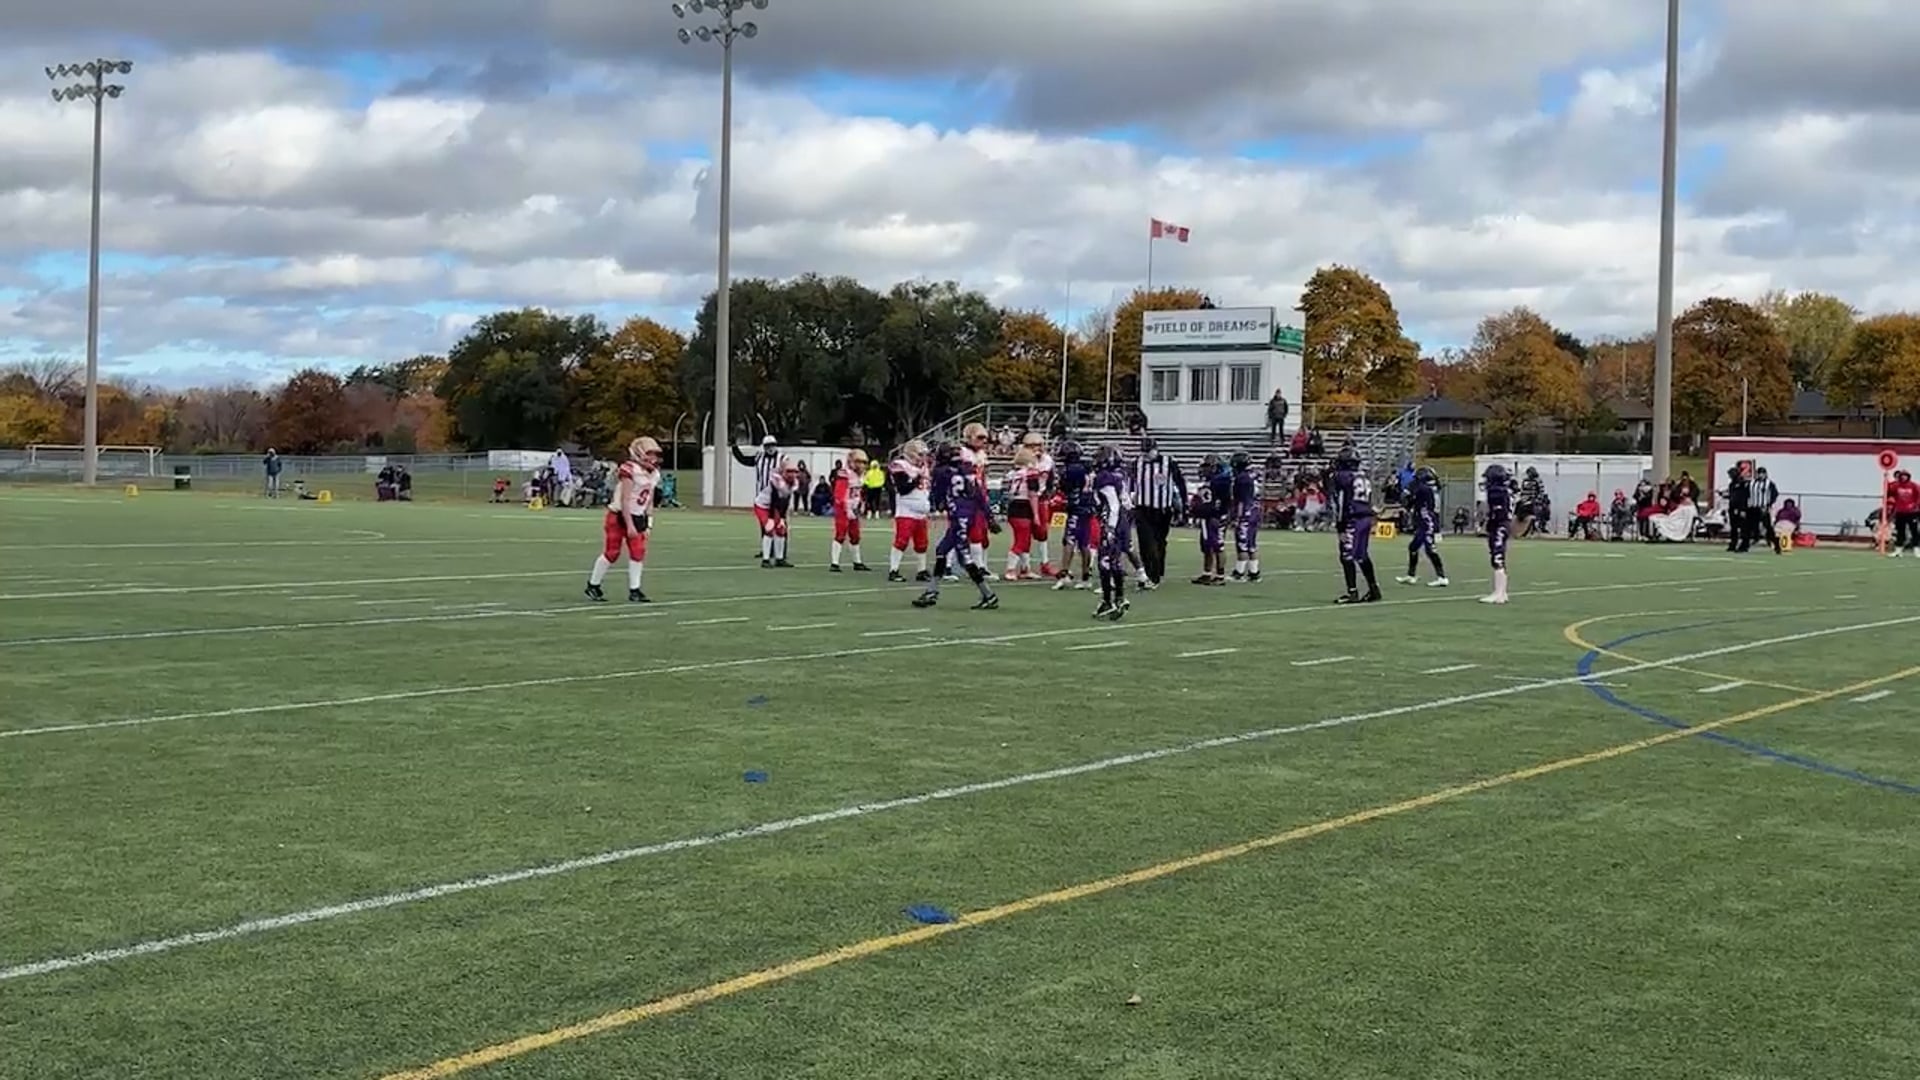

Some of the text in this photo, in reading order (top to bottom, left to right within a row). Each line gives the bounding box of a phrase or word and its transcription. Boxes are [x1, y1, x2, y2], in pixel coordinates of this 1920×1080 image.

[1153, 320, 1257, 334] FIELD OF DREAMS
[1740, 461, 1750, 476] 2
[1378, 524, 1392, 537] 40
